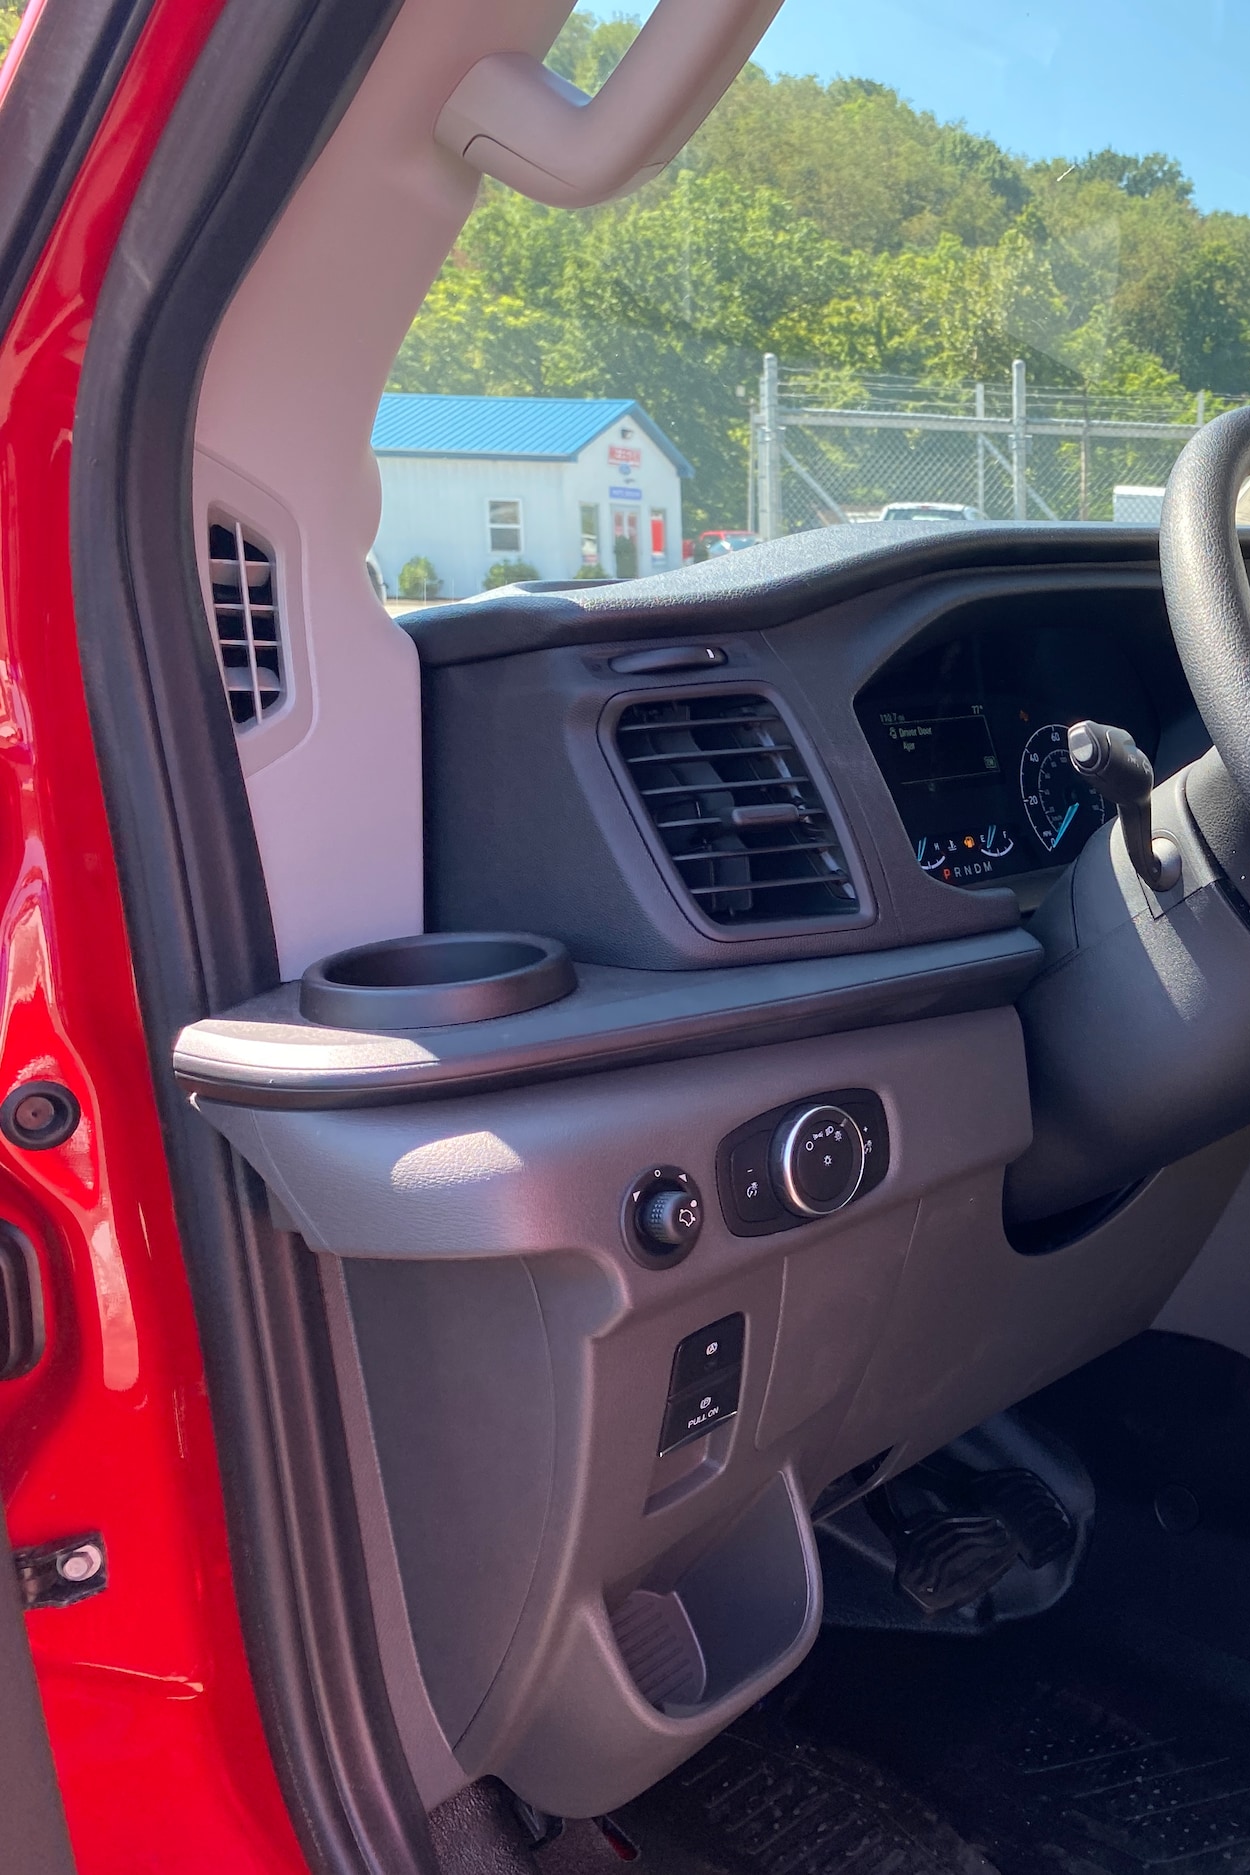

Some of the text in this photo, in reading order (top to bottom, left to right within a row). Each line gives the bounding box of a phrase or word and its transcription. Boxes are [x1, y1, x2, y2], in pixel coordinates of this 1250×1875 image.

[1050, 732, 1060, 742] 60
[1030, 752, 1040, 763] 40
[1028, 795, 1038, 805] 20
[980, 834, 986, 842] E
[1002, 830, 1007, 839] F
[687, 1406, 719, 1429] PULL ON
